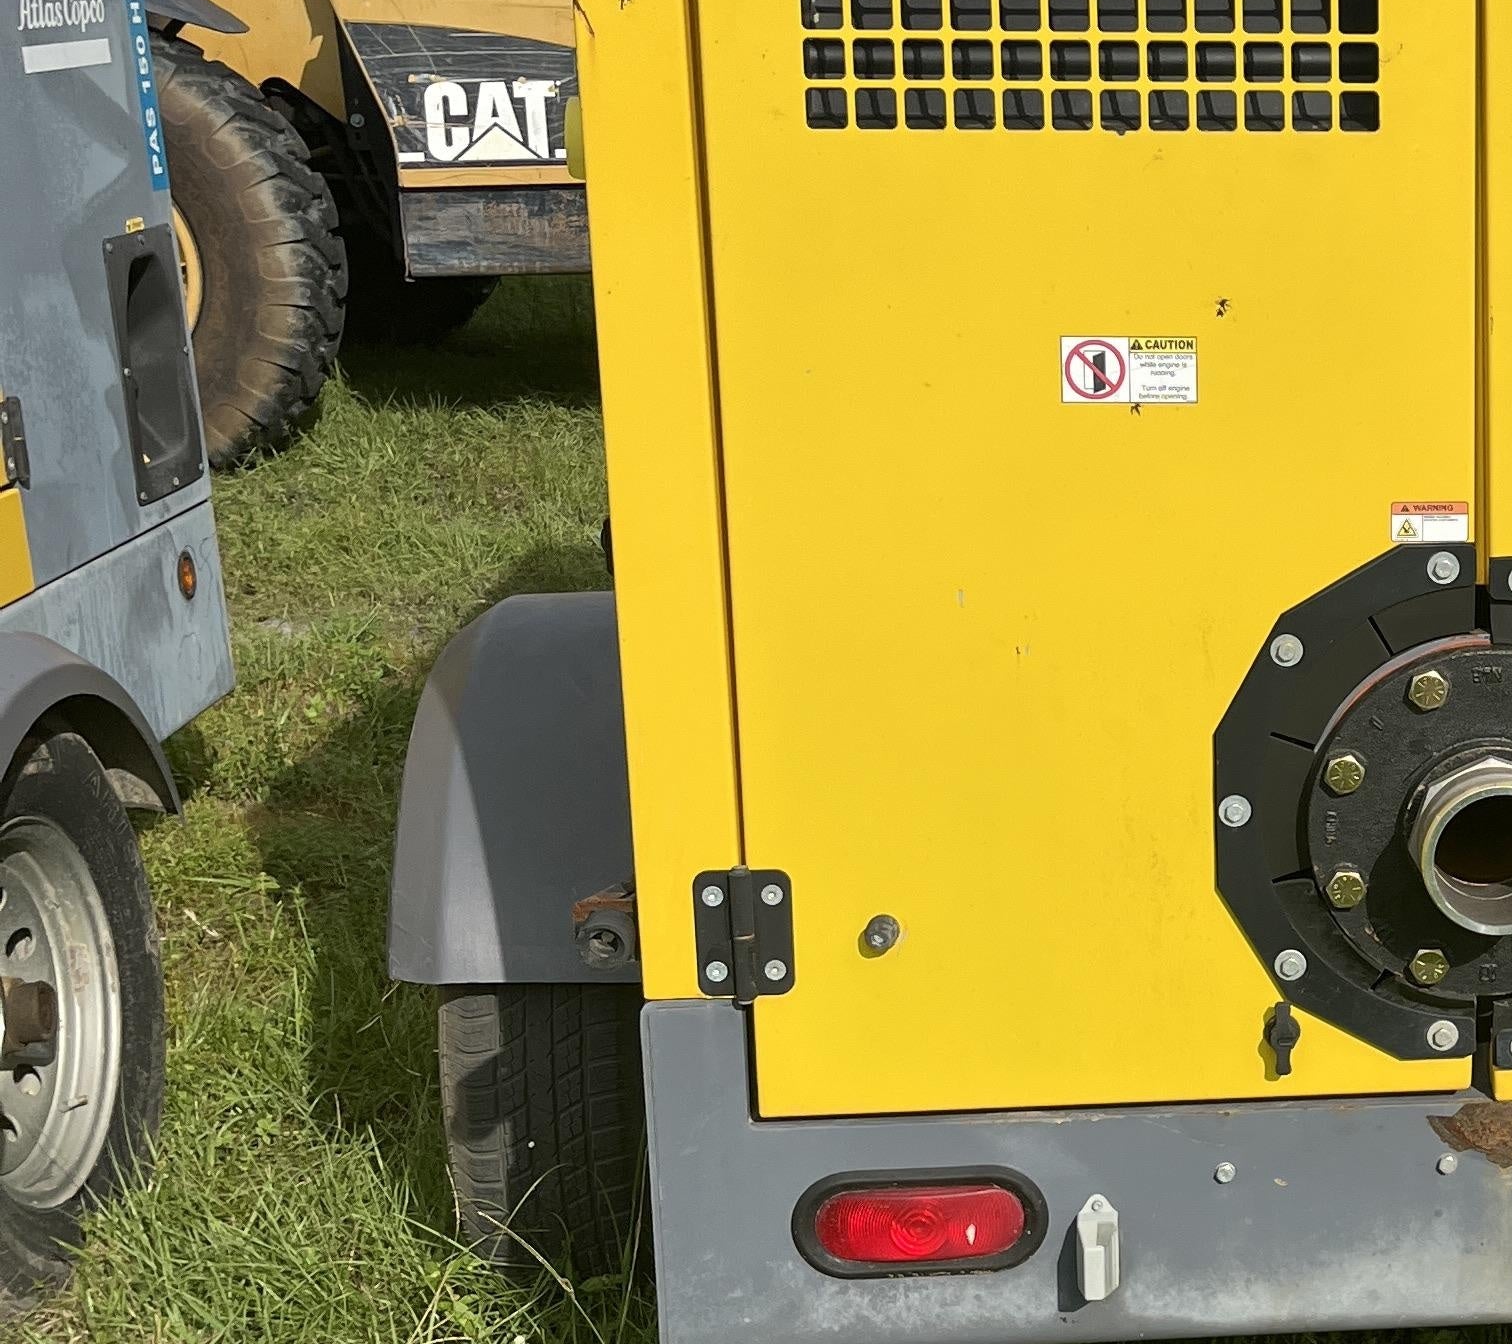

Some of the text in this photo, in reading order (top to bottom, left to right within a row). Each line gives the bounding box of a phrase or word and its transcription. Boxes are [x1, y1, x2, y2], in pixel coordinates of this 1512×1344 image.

[136, 35, 151, 93] 150
[145, 107, 163, 175] PAS
[423, 80, 556, 162] CAT
[1145, 339, 1194, 350] CAUTION
[1412, 504, 1454, 512] WARNING
